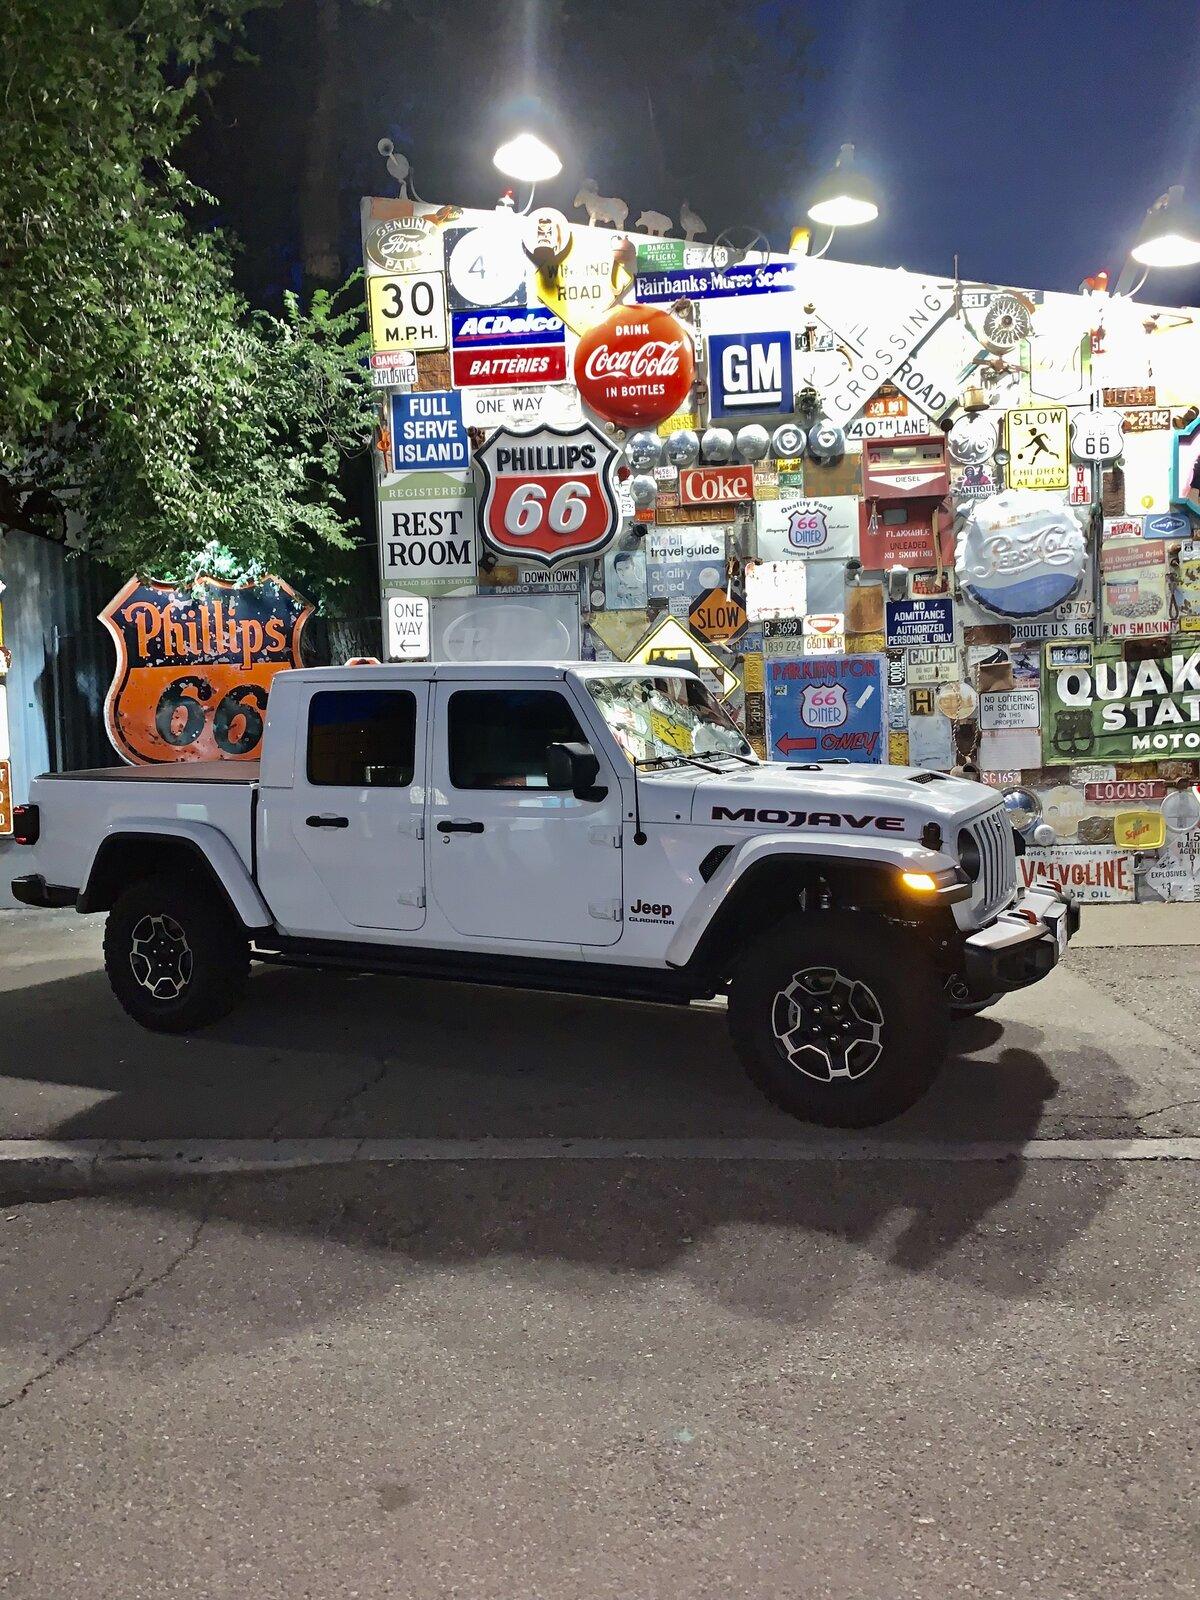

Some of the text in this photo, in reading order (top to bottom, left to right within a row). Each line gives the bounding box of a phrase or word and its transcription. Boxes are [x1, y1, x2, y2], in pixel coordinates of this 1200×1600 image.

[376, 218, 430, 237] GENUIN
[647, 243, 675, 252] DANGER
[647, 253, 676, 261] PELIGRO
[381, 281, 434, 319] 30
[557, 285, 601, 301] ROAD
[961, 294, 988, 308] SELF
[458, 314, 563, 336] ACDelco
[615, 323, 649, 336] DRINK
[385, 325, 438, 342] M.P.H.
[376, 354, 407, 366] DANGE
[584, 341, 684, 381] Coca-Cola
[834, 294, 942, 412] CROSSING
[469, 356, 550, 377] BATTERIES
[722, 341, 782, 393] GM
[373, 369, 416, 385] EXPLOSIVES
[605, 384, 665, 397] IN BOTTLES
[898, 359, 947, 412] ROAD
[409, 398, 451, 417] FULL
[476, 396, 543, 414] ONE WAY
[1013, 411, 1064, 427] SLOW
[403, 419, 458, 440] SERVE
[852, 418, 926, 437] 40TH LANE
[399, 442, 464, 462] ISLAND
[1086, 437, 1110, 455] 66
[496, 444, 597, 472] PHILLIPS
[895, 475, 921, 483] DIESEL
[1013, 467, 1065, 476] CHILDREN
[685, 470, 748, 501] Coke
[1035, 477, 1062, 485] PLAY
[388, 486, 467, 498] REGISTERED
[504, 481, 591, 536] 66
[781, 501, 833, 514] Quality Food
[392, 510, 463, 537] REST
[797, 516, 818, 529] 66
[650, 534, 683, 547] Mobil
[795, 529, 822, 543] DINER
[387, 540, 472, 567] ROOM
[650, 545, 720, 558] travel guide
[889, 541, 927, 550] UNLEADED
[394, 603, 424, 618] ONE
[913, 602, 926, 611] NO
[697, 606, 739, 629] SLOW
[894, 609, 946, 622] ADMITTANCE
[394, 622, 424, 636] WAY
[777, 621, 798, 631] 3699
[896, 623, 945, 635] AUTHORIZED
[1016, 622, 1088, 637] ROUTE U.S. 66
[1112, 624, 1126, 635] NO
[121, 600, 286, 670] Phillips
[888, 632, 952, 645] PERSONNEL ONLY
[909, 648, 956, 664] CAUTION
[772, 659, 876, 680] PARKING FOR
[811, 690, 837, 706] 66
[984, 694, 1034, 704] NO LOITERING
[155, 675, 269, 755] 66
[808, 707, 842, 723] DINER
[997, 703, 1036, 711] SOLICITING
[1095, 782, 1156, 799] LOCUST
[711, 806, 905, 832] MOJAVE
[1185, 832, 1200, 842] 1.5
[1019, 856, 1129, 891] VALVOLINE
[1151, 870, 1187, 878] EXPLOSIVES
[630, 899, 672, 918] Jeep
[628, 916, 675, 926] GLADIATOR
